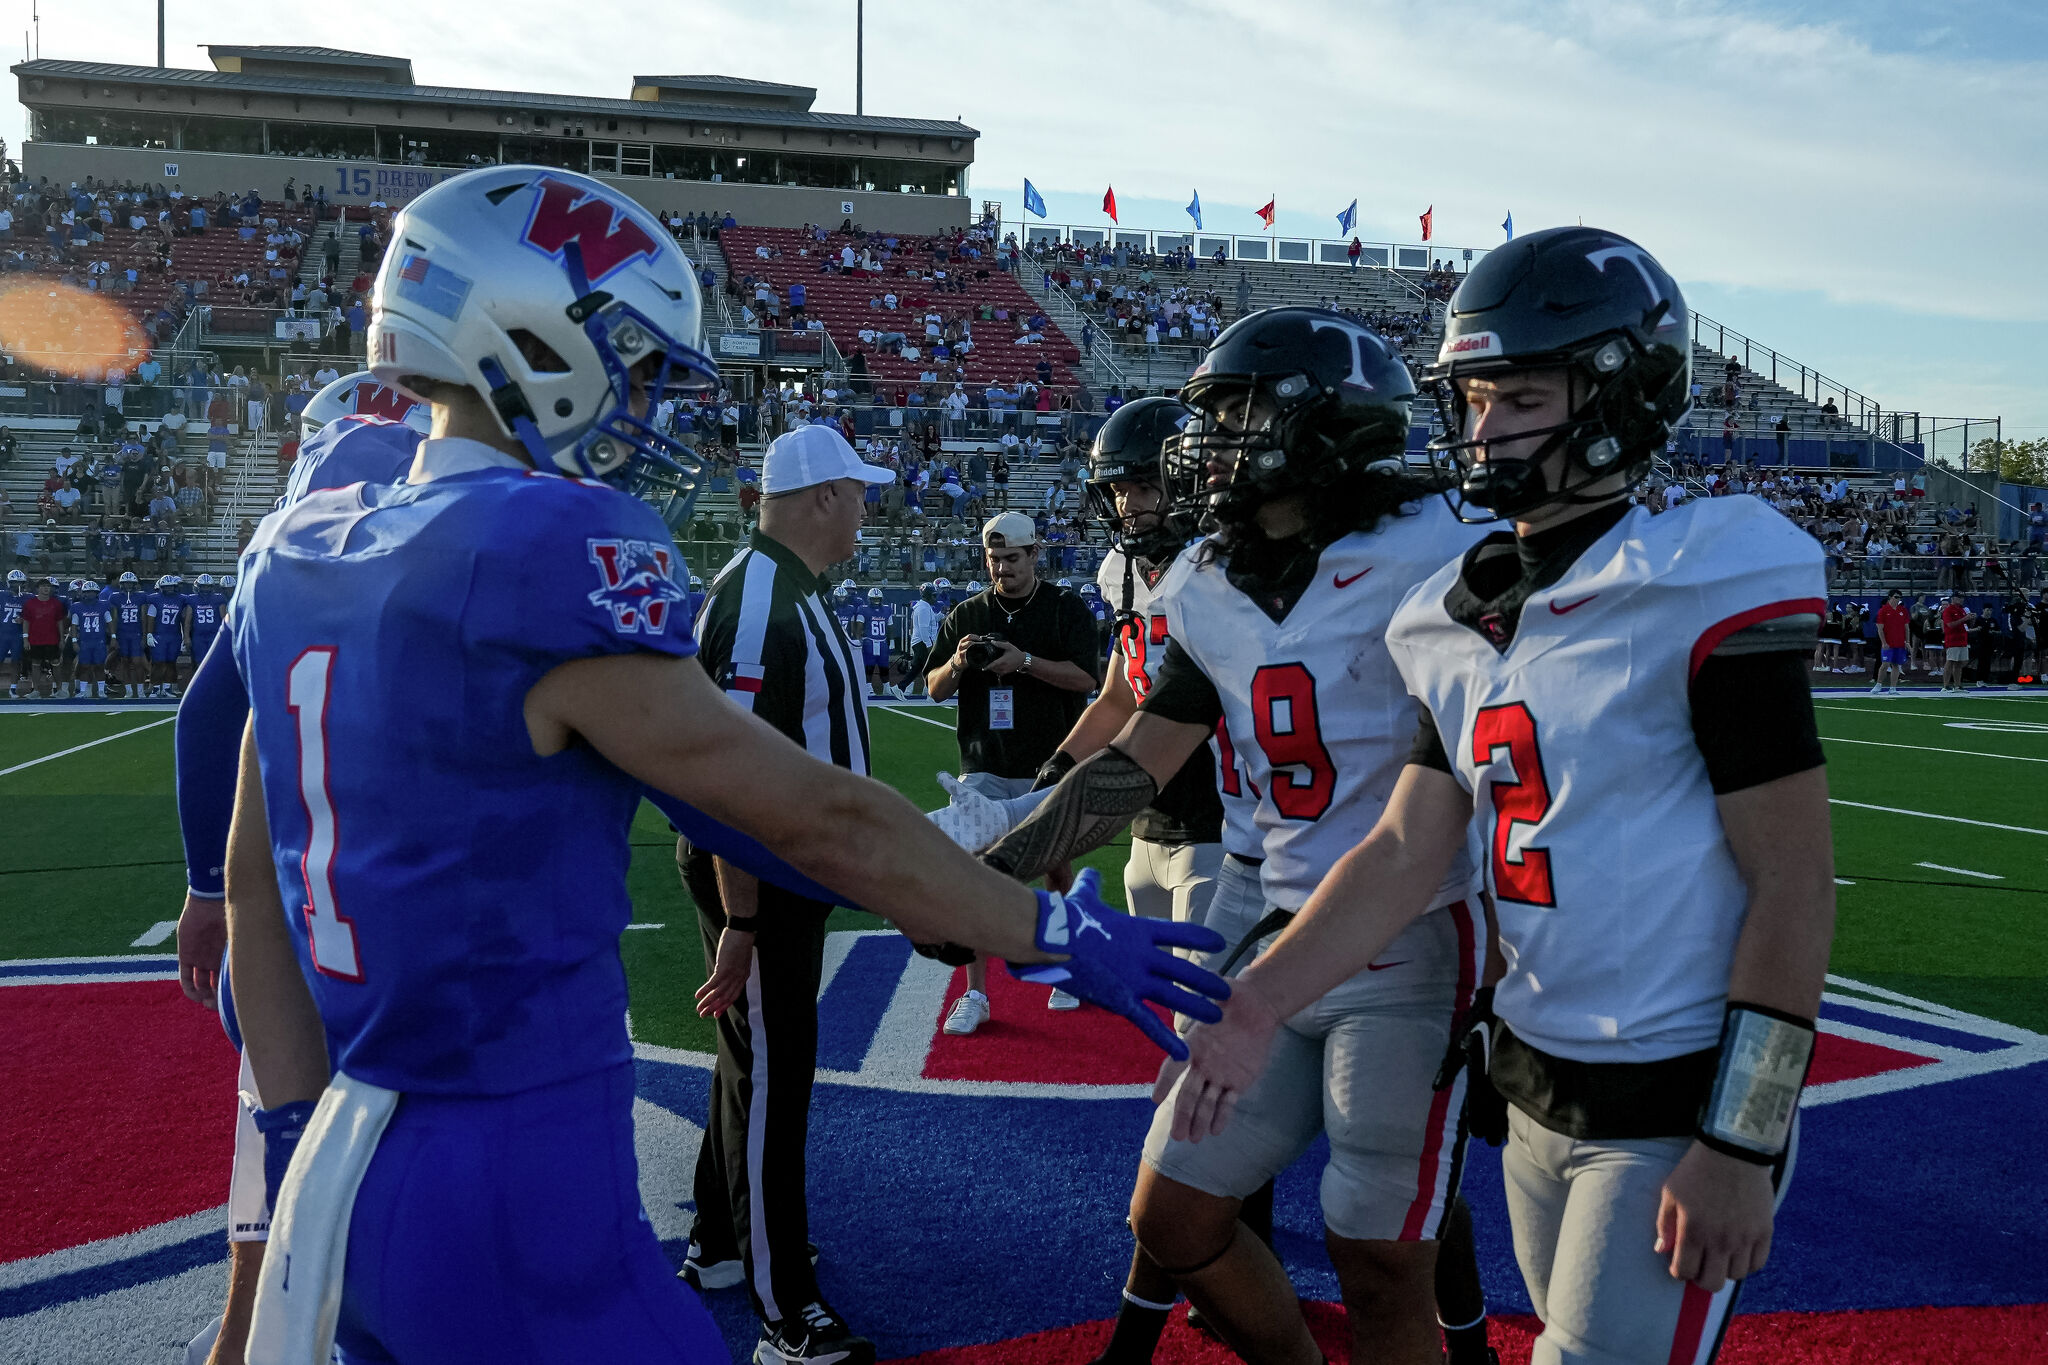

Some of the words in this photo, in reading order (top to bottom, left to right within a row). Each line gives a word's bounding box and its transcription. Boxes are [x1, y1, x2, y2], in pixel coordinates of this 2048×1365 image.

[166, 166, 177, 175] W
[335, 167, 372, 196] 15
[376, 170, 434, 187] DREW
[844, 204, 851, 213] S
[520, 172, 664, 289] W
[1584, 244, 1678, 330] T
[1310, 318, 1393, 391] T
[353, 380, 421, 423] W
[83, 616, 100, 632] 44
[161, 608, 179, 625] 67
[196, 608, 214, 624] 59
[871, 620, 886, 636] 60
[1251, 661, 1338, 822] 9
[286, 645, 366, 984] 1
[1472, 700, 1557, 909] 2
[235, 1223, 251, 1232] WE
